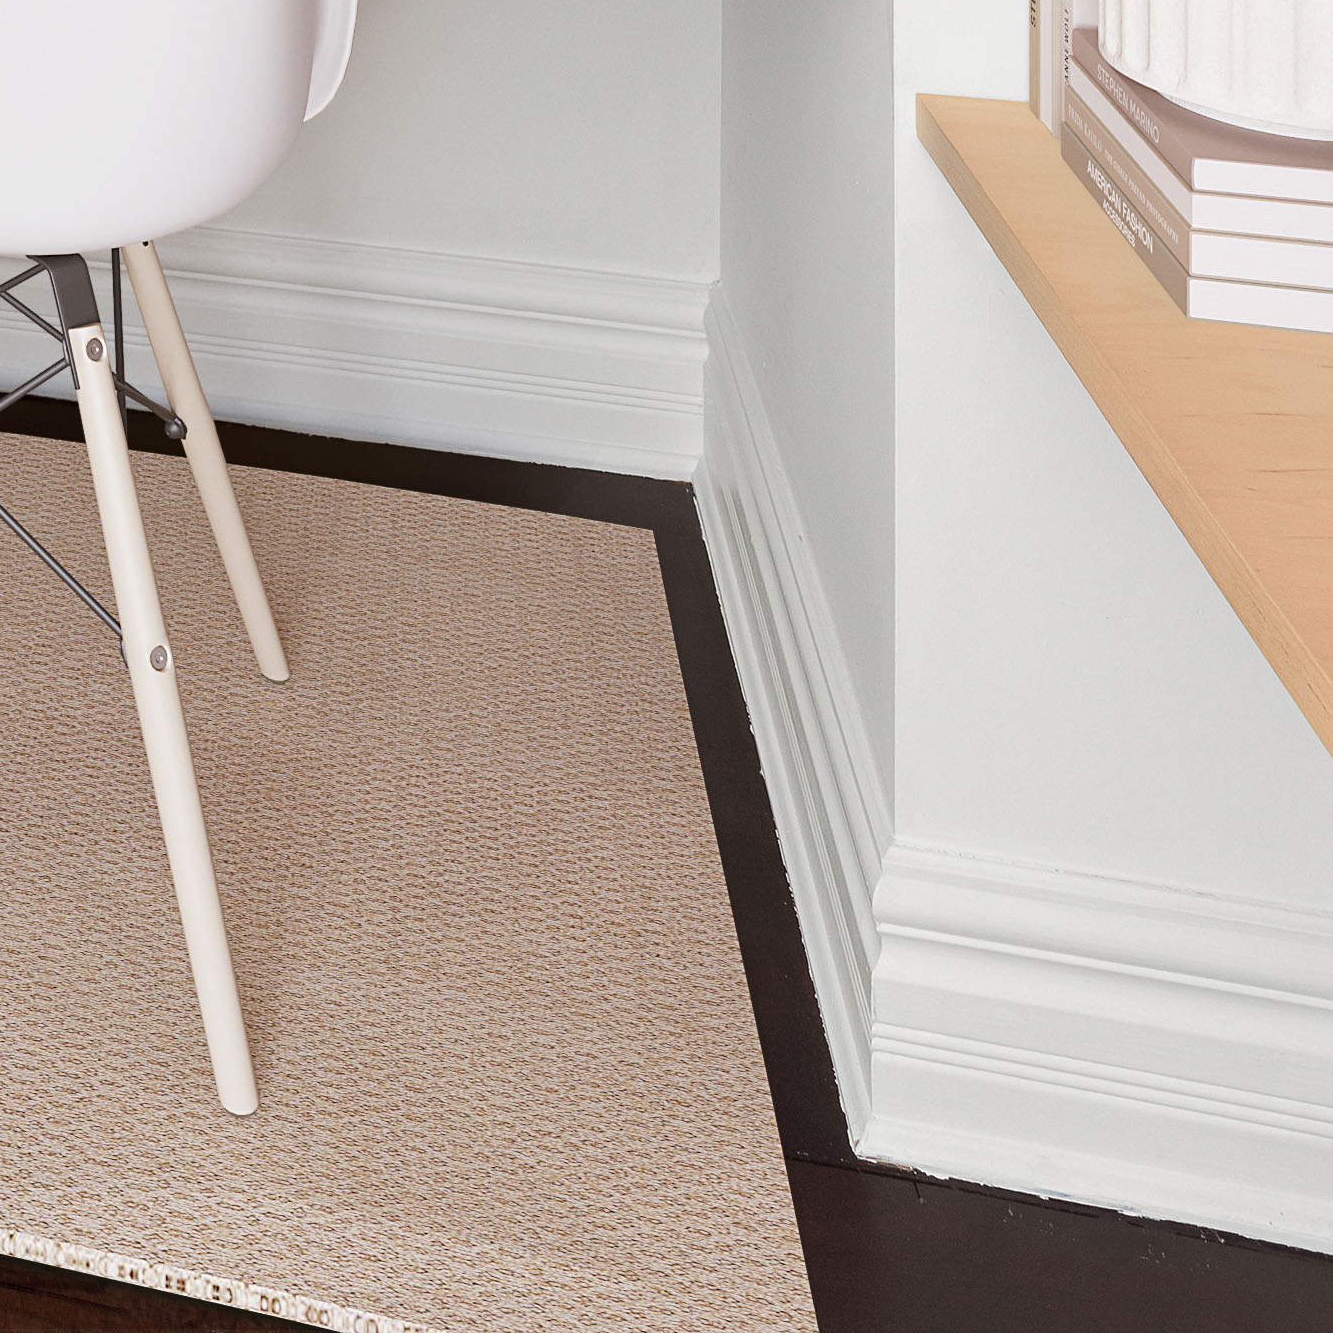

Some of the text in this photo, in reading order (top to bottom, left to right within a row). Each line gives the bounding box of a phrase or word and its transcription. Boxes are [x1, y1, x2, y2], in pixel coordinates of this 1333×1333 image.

[1097, 64, 1160, 144] STEPHEN MARINO
[1087, 159, 1154, 253] AMERICAN FASHION
[1102, 199, 1136, 248] ACCESSORIES
